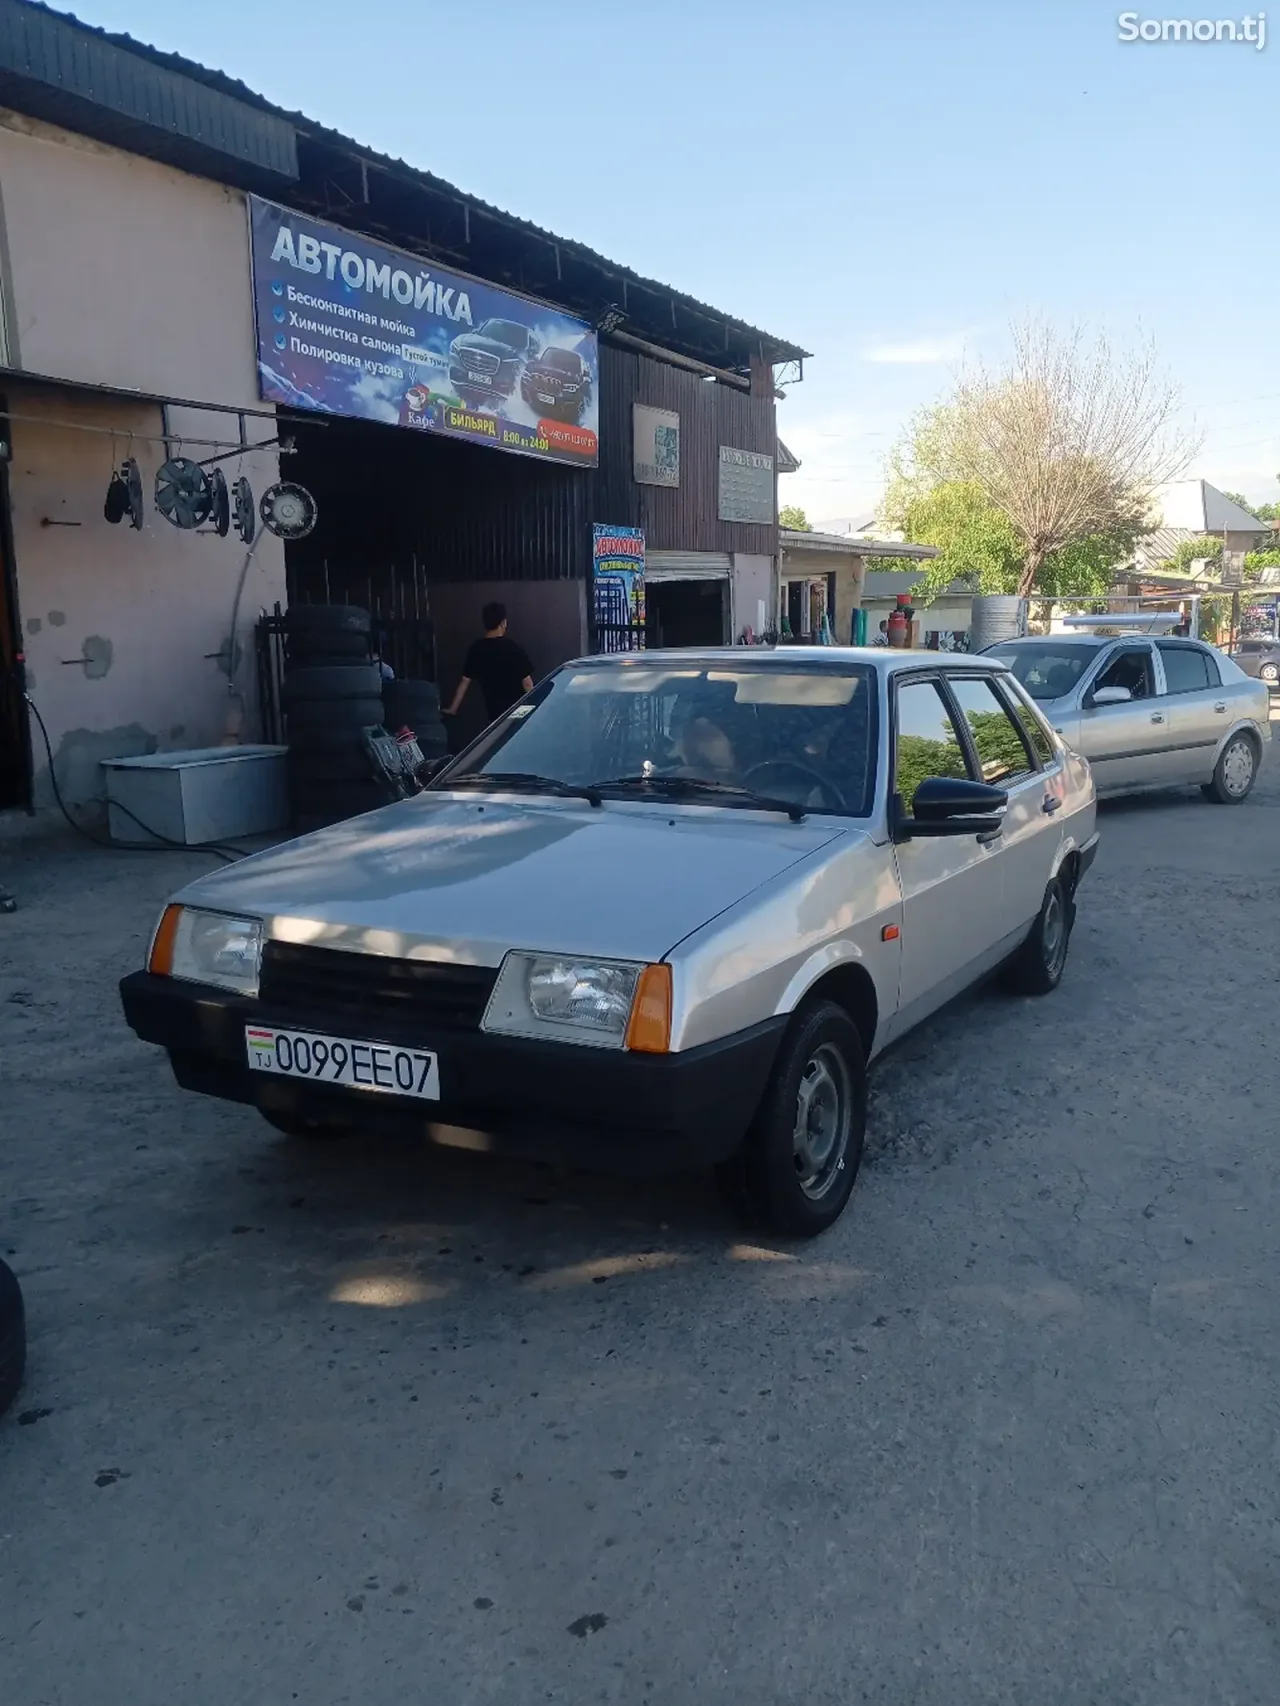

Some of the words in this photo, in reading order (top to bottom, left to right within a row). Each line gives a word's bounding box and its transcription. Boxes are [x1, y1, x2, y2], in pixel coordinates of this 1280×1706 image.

[270, 226, 474, 326] АВТОМОЙКА
[286, 284, 378, 326] Бесконтактная
[380, 320, 416, 337] мойка
[288, 310, 359, 343] Химчистка
[361, 335, 401, 356] салона
[290, 336, 361, 368] Полировка
[364, 359, 404, 379] кузова
[404, 348, 428, 362] Густой
[408, 411, 435, 429] Кафе
[450, 411, 496, 436] БИЛЬЯРД
[503, 430, 520, 444] 8:00
[255, 1052, 272, 1068] TJ
[275, 1034, 432, 1093] 0099EE07
